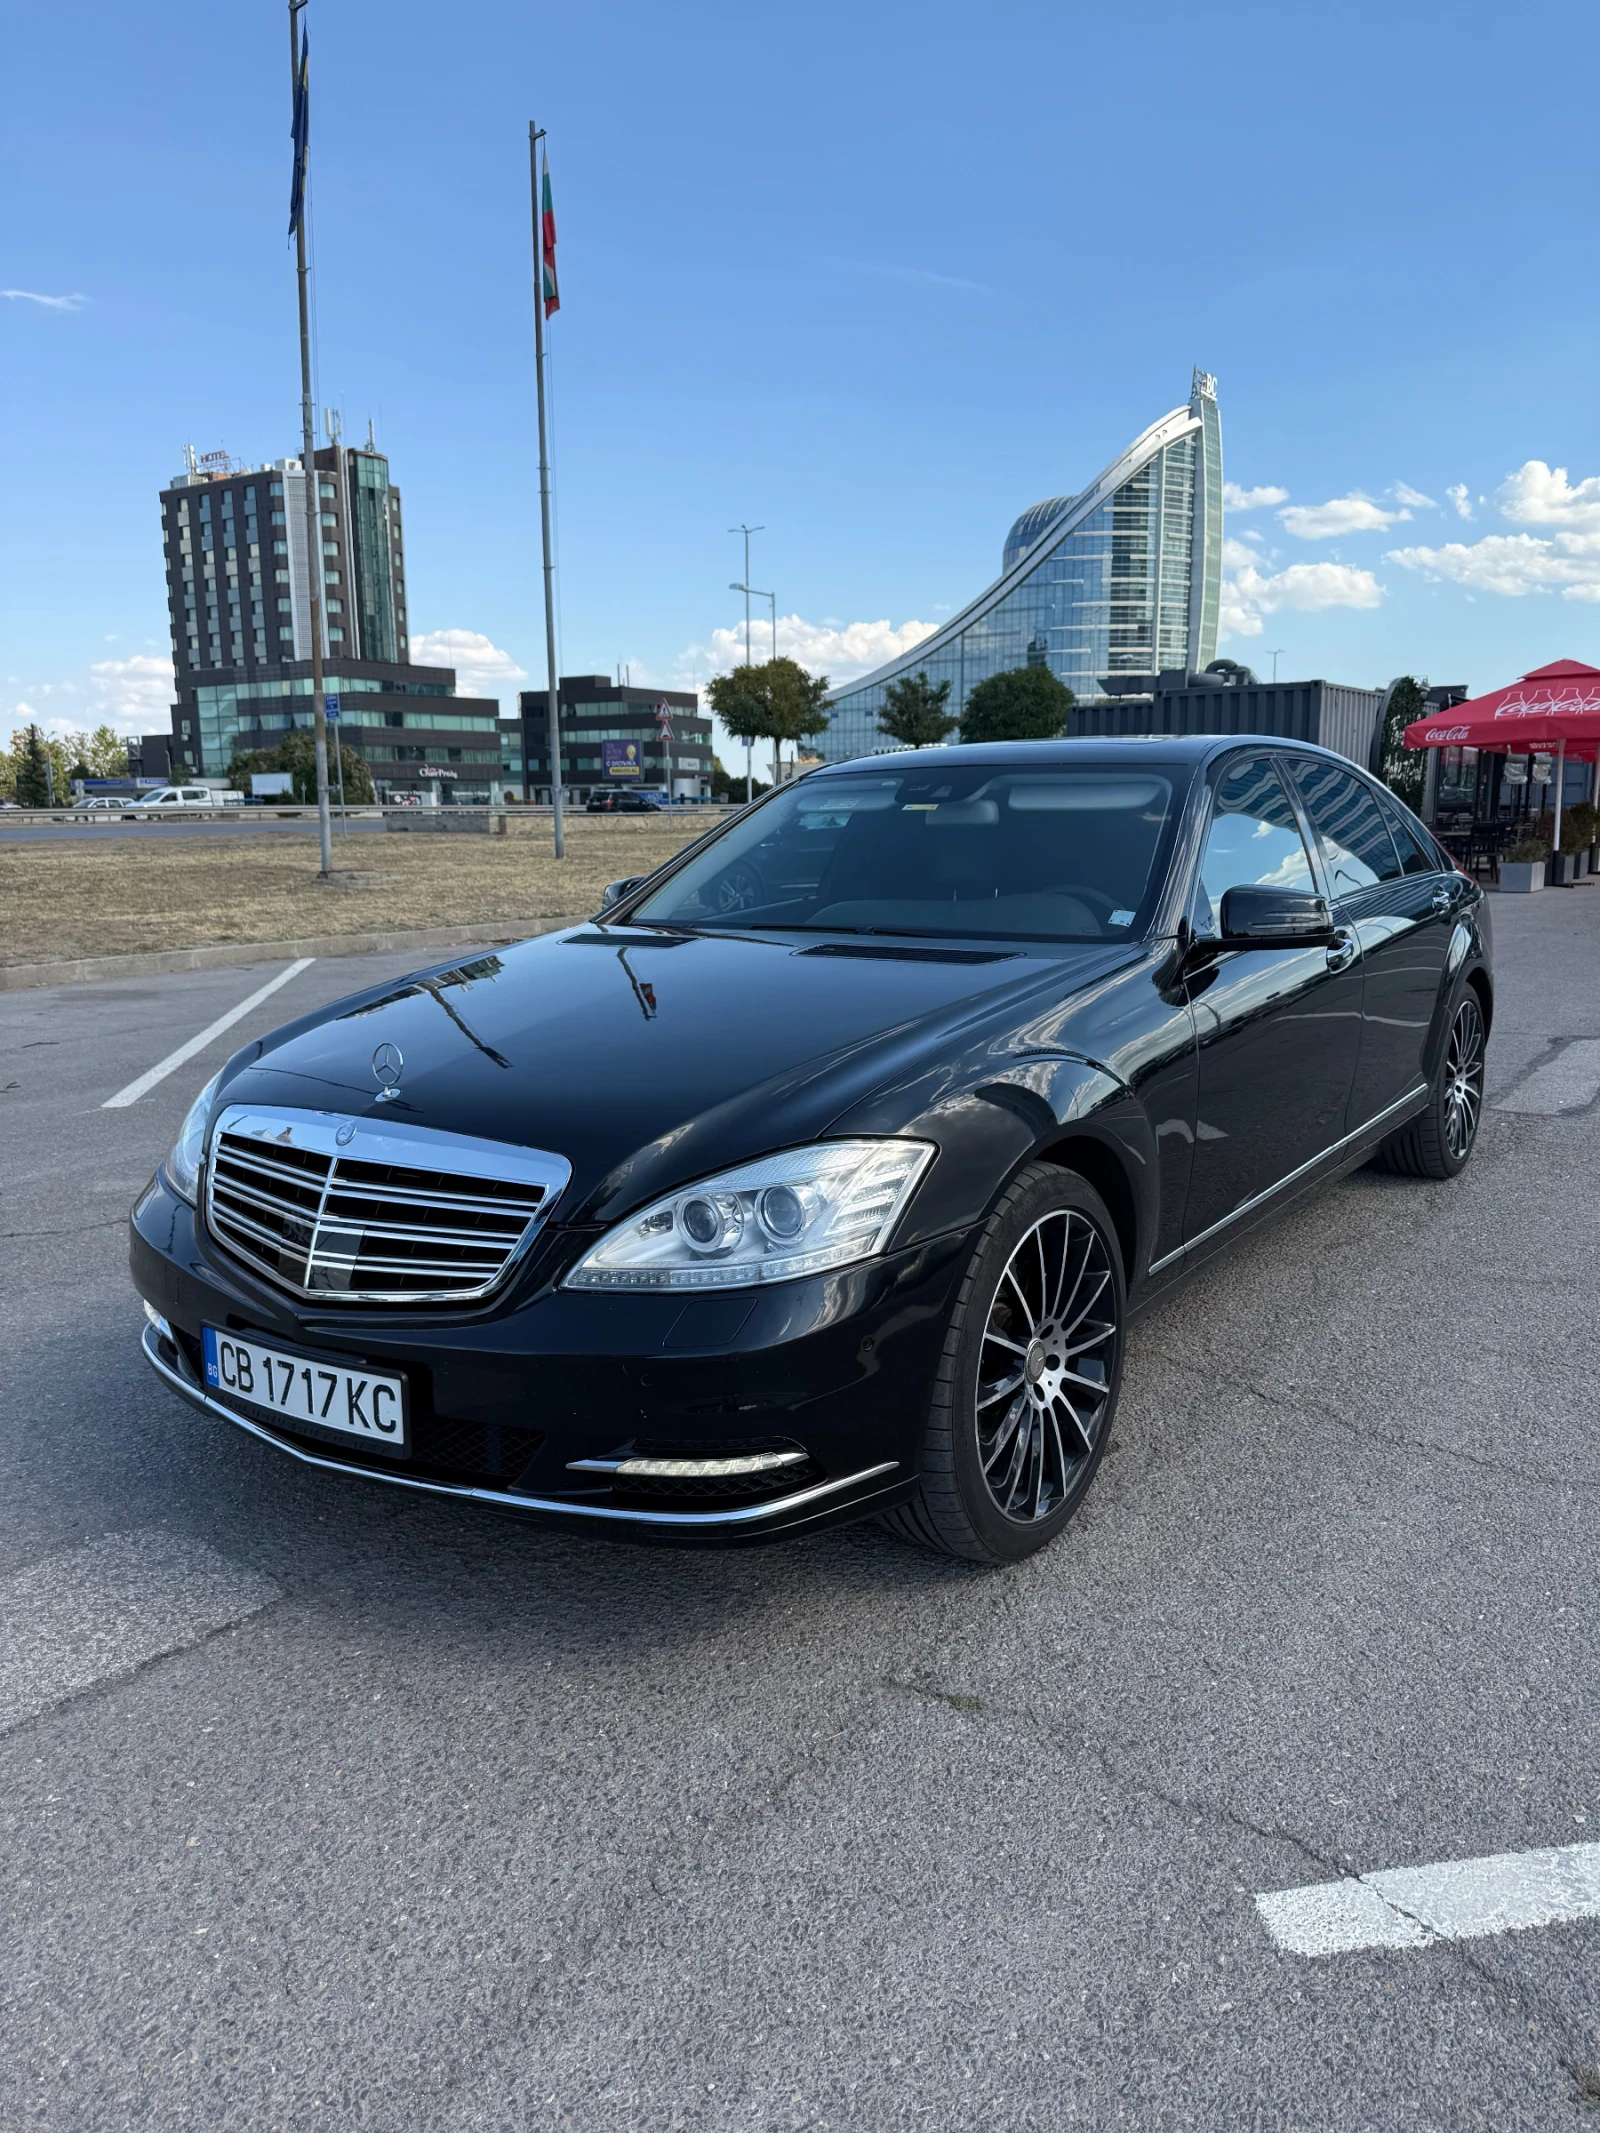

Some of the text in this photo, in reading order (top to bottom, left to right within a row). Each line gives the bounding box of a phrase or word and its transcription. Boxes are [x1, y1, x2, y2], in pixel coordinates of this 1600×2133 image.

[200, 450, 230, 463] HOTEL
[207, 1363, 218, 1378] BG
[221, 1341, 397, 1433] CB 1717 KC
